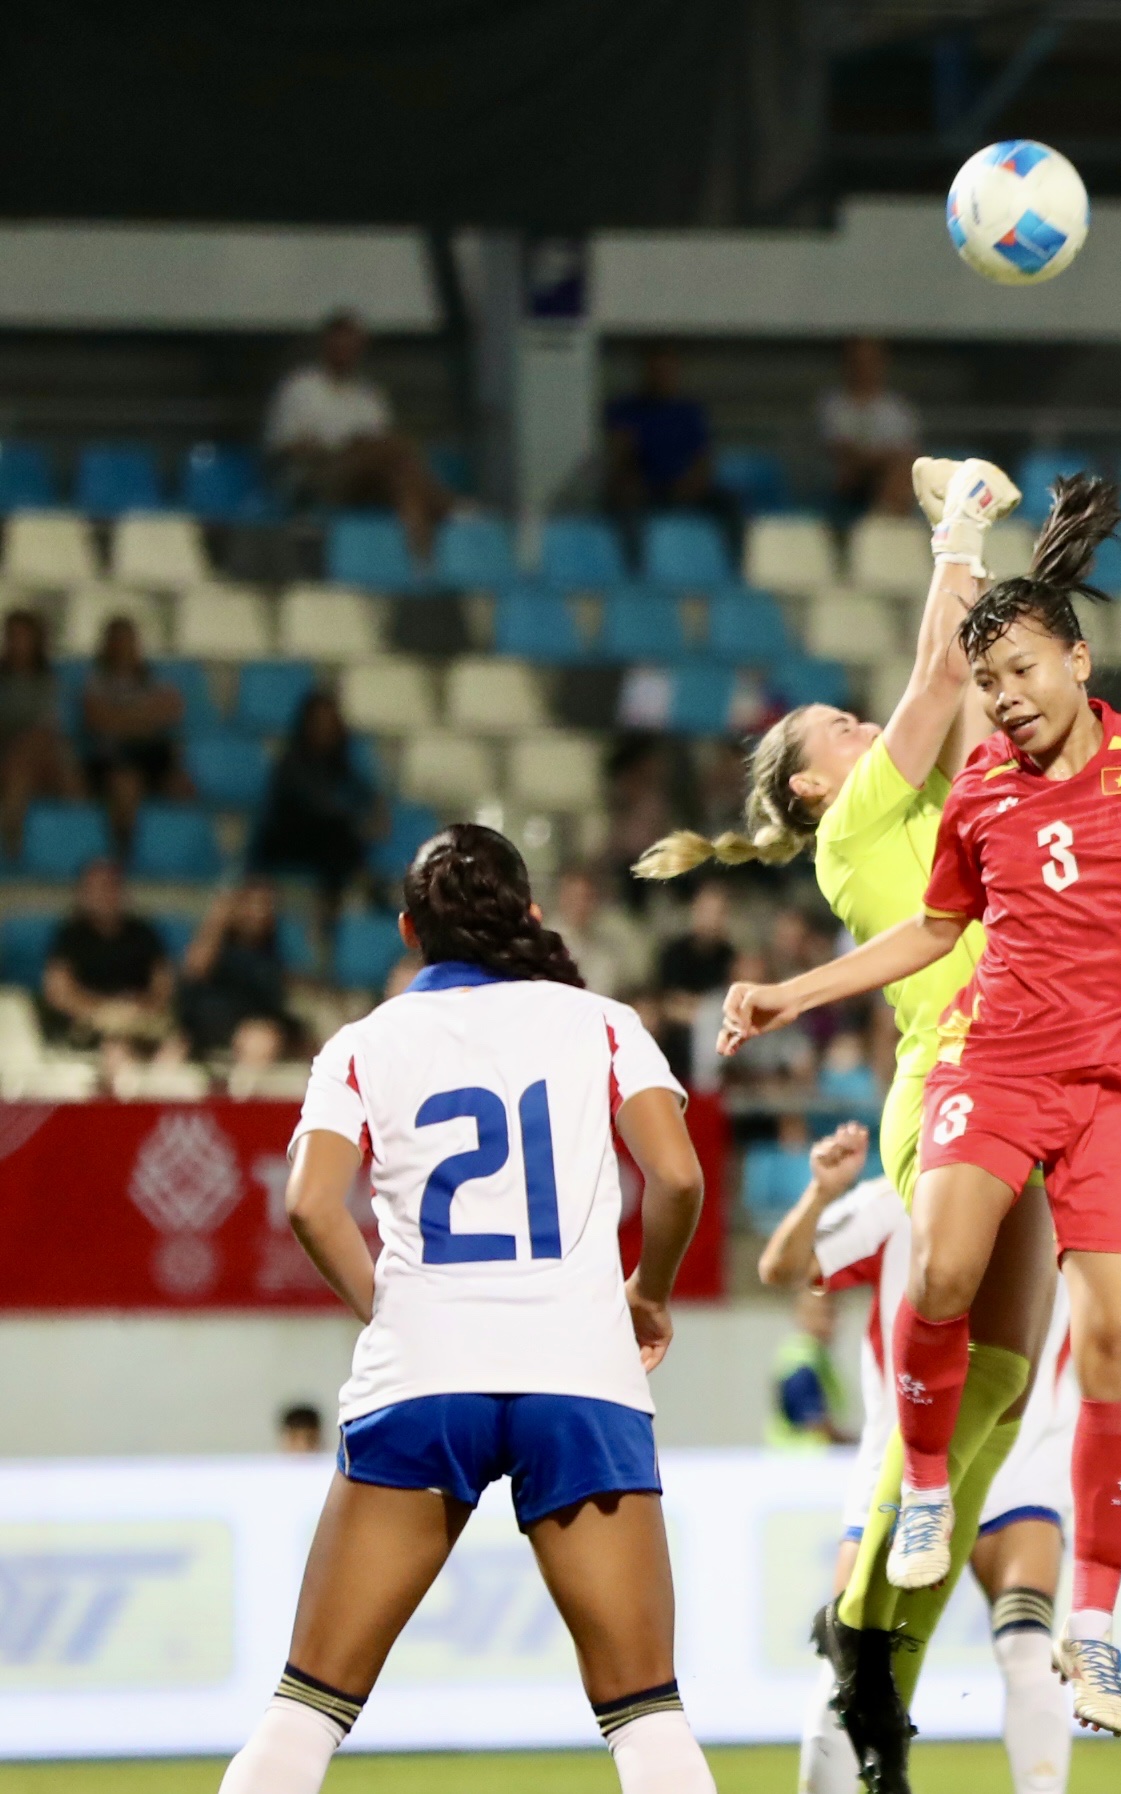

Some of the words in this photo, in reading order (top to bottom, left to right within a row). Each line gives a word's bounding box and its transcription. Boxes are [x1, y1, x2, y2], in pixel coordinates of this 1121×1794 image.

[1037, 820, 1080, 893] 3
[932, 1093, 975, 1146] 3
[414, 1079, 563, 1265] 21
